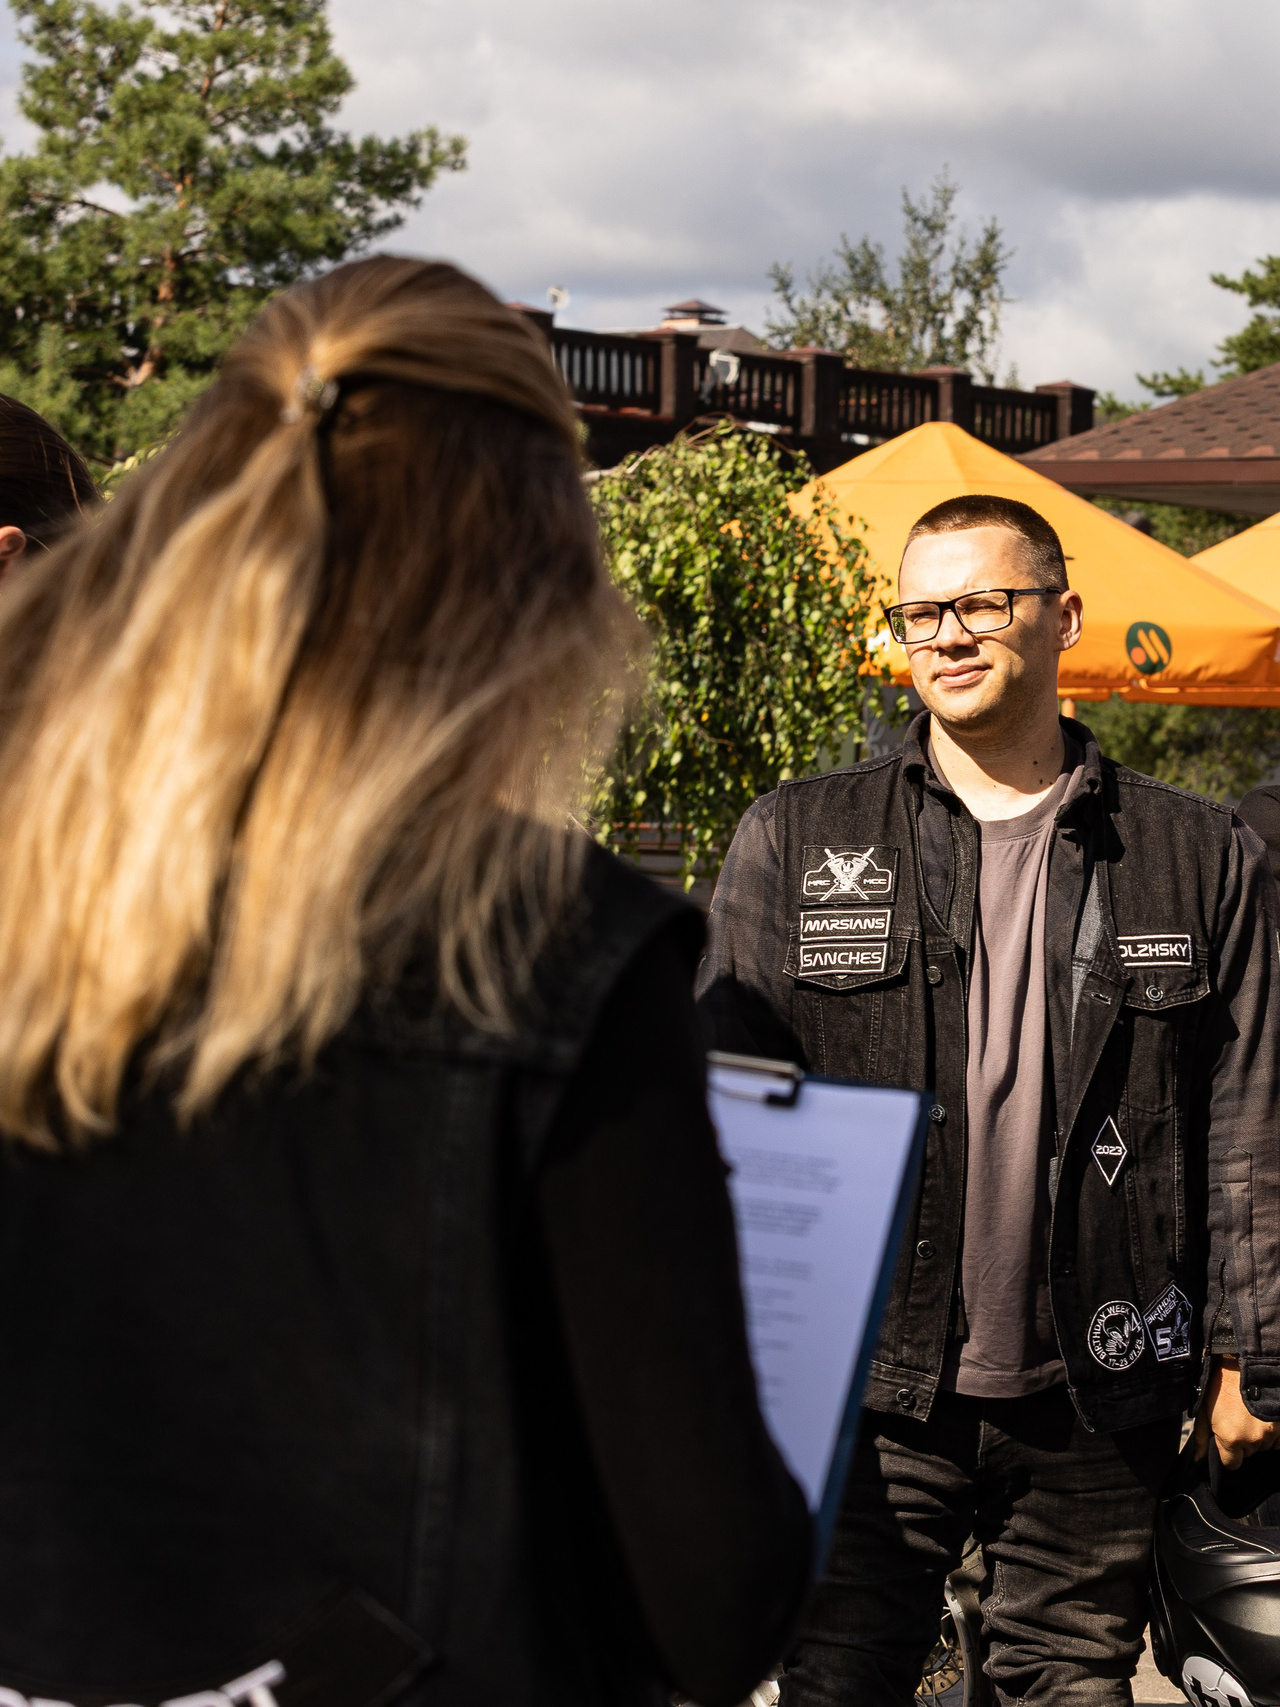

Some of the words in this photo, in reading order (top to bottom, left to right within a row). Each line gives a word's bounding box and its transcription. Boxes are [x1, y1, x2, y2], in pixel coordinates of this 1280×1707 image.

[803, 918, 885, 933] MARSIANS
[1118, 943, 1188, 958] OLZHSKY
[803, 951, 882, 967] SANCHES
[1095, 1145, 1123, 1156] 2023
[1092, 1310, 1107, 1360] BIRTHDAY
[1106, 1305, 1130, 1315] WEEK
